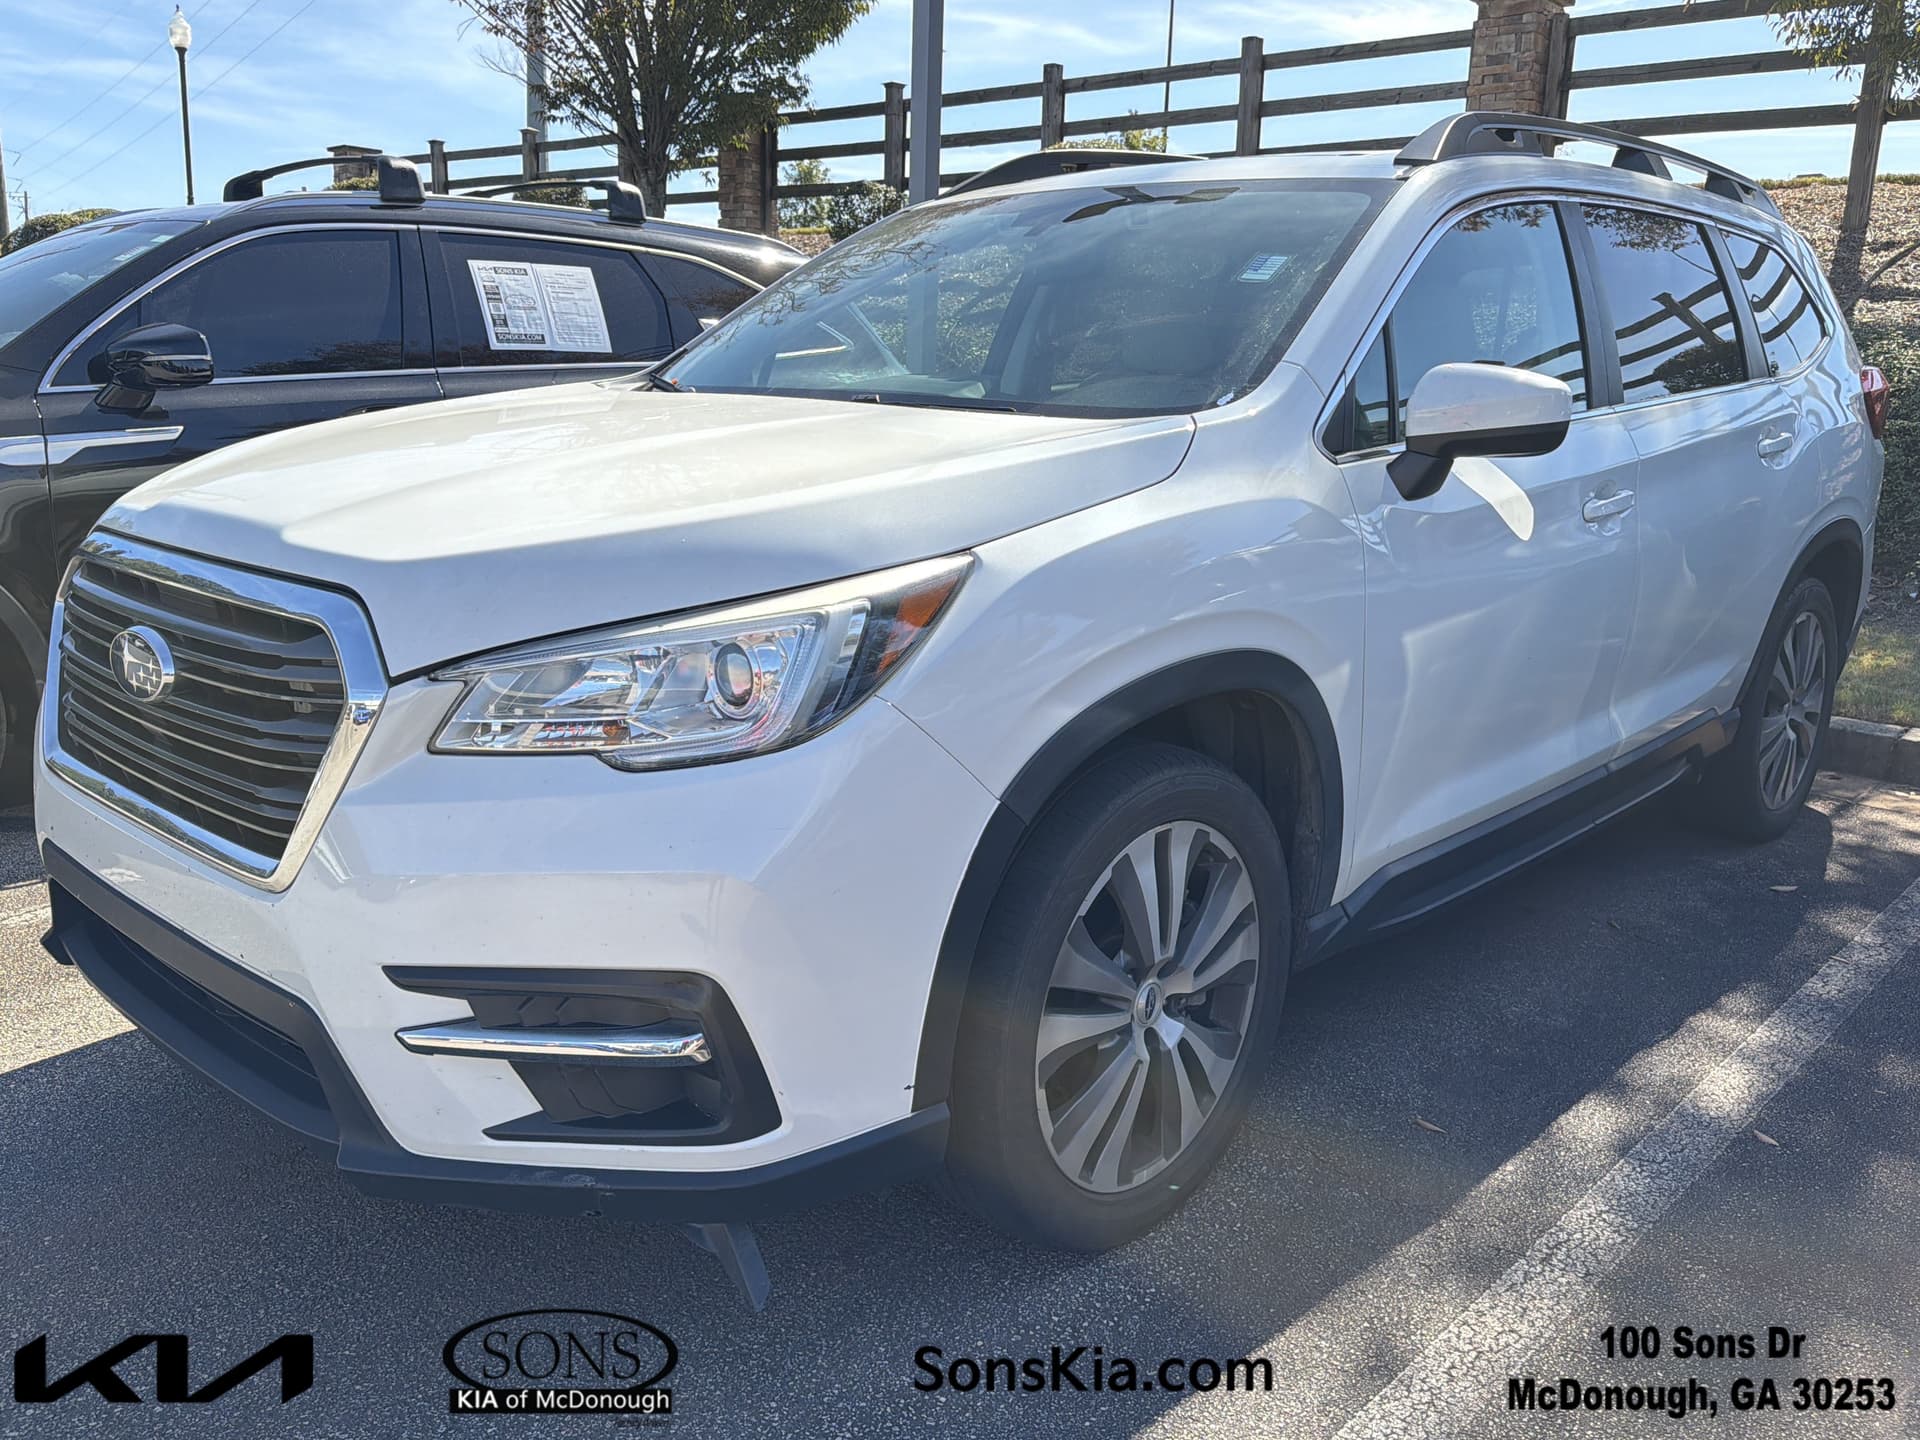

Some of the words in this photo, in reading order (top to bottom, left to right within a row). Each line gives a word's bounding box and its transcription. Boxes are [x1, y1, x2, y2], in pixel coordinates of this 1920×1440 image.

[495, 266, 515, 275] SONS
[515, 267, 527, 276] KIA
[497, 333, 543, 341] SONSKIA.COM
